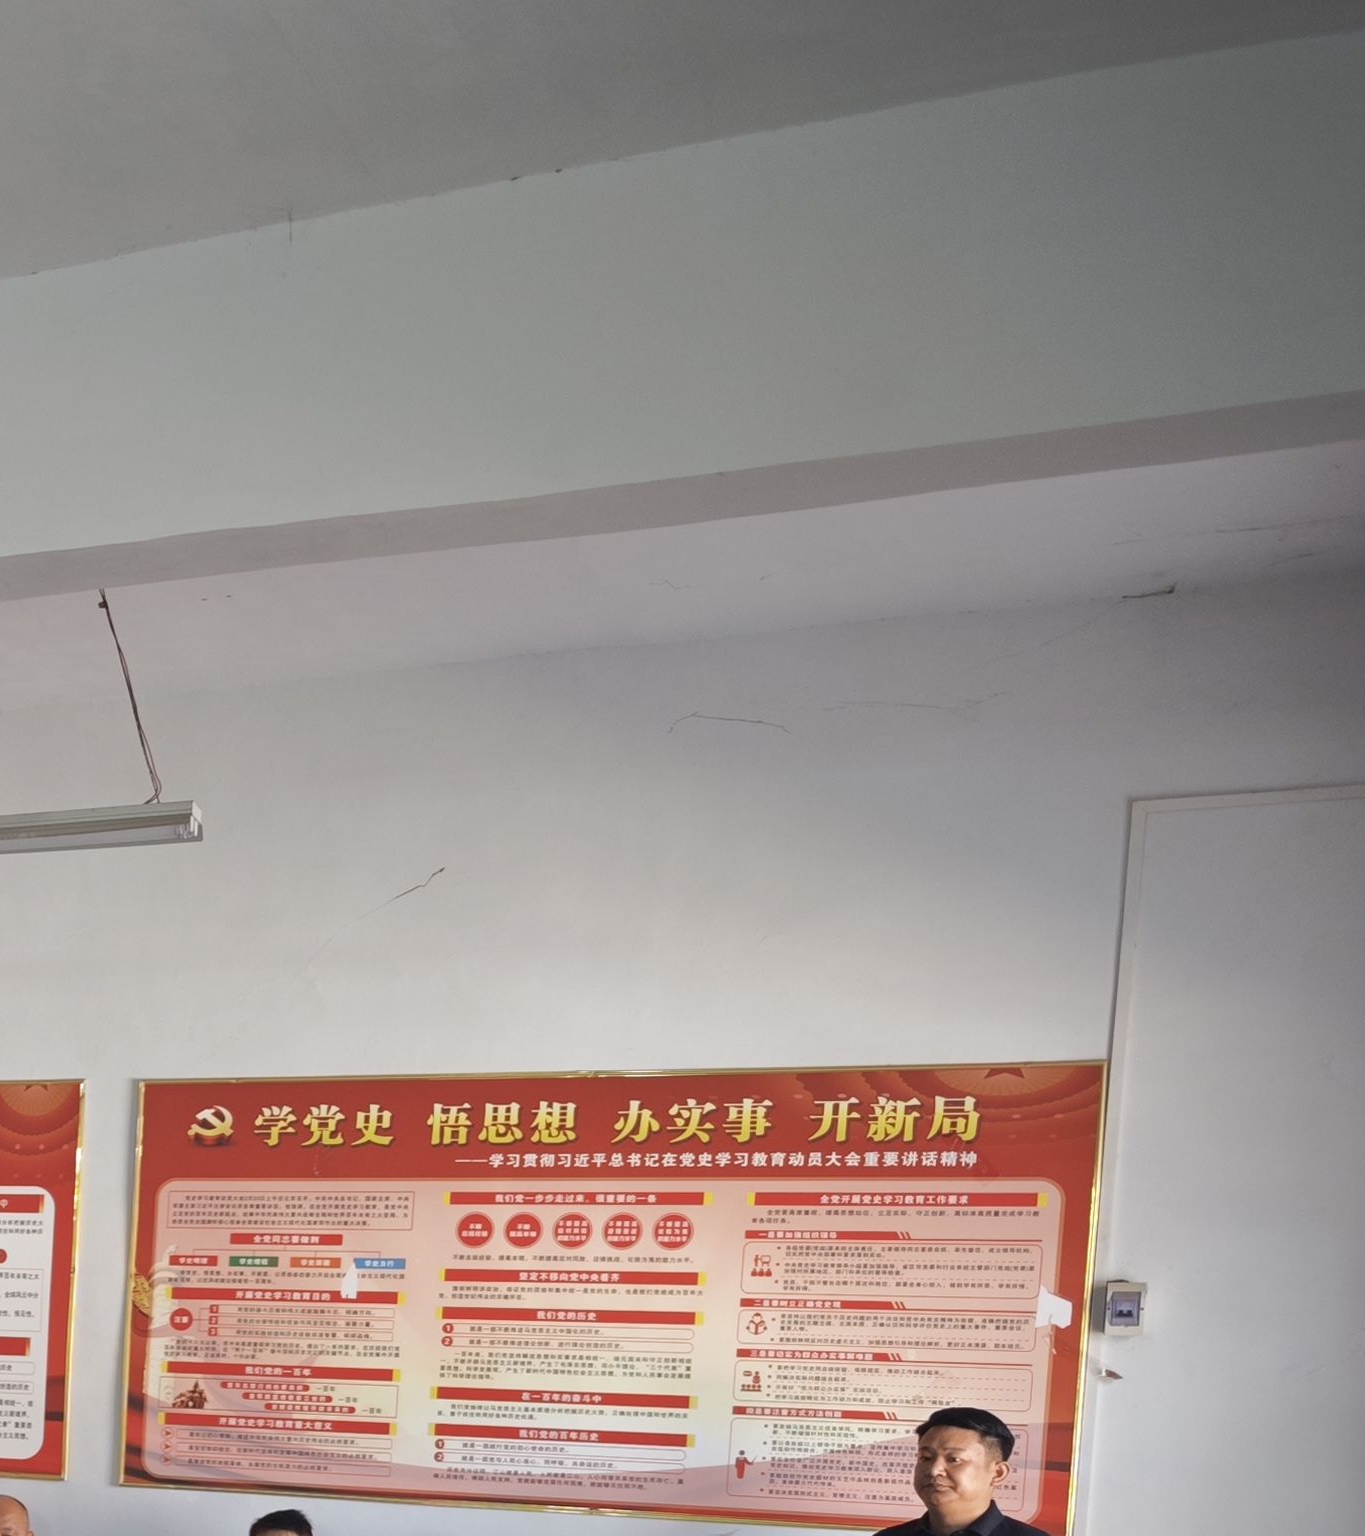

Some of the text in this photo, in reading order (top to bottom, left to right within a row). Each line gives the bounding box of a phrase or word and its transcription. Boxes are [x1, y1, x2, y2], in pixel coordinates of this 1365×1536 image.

[253, 1096, 980, 1149] 学党史 悟思想 办实事 开新局
[820, 1195, 968, 1205] 全党开展党史学习教育工作要求
[519, 1272, 620, 1282] 坚定不移向党中央看齐
[235, 1291, 330, 1301] 开展党史学习教育目的
[537, 1311, 596, 1321] 我们党的历史
[245, 1367, 312, 1376] 我们党的一百年
[522, 1393, 601, 1403] 在一百年的奋斗中
[519, 1429, 599, 1441] 我们党的百年历史
